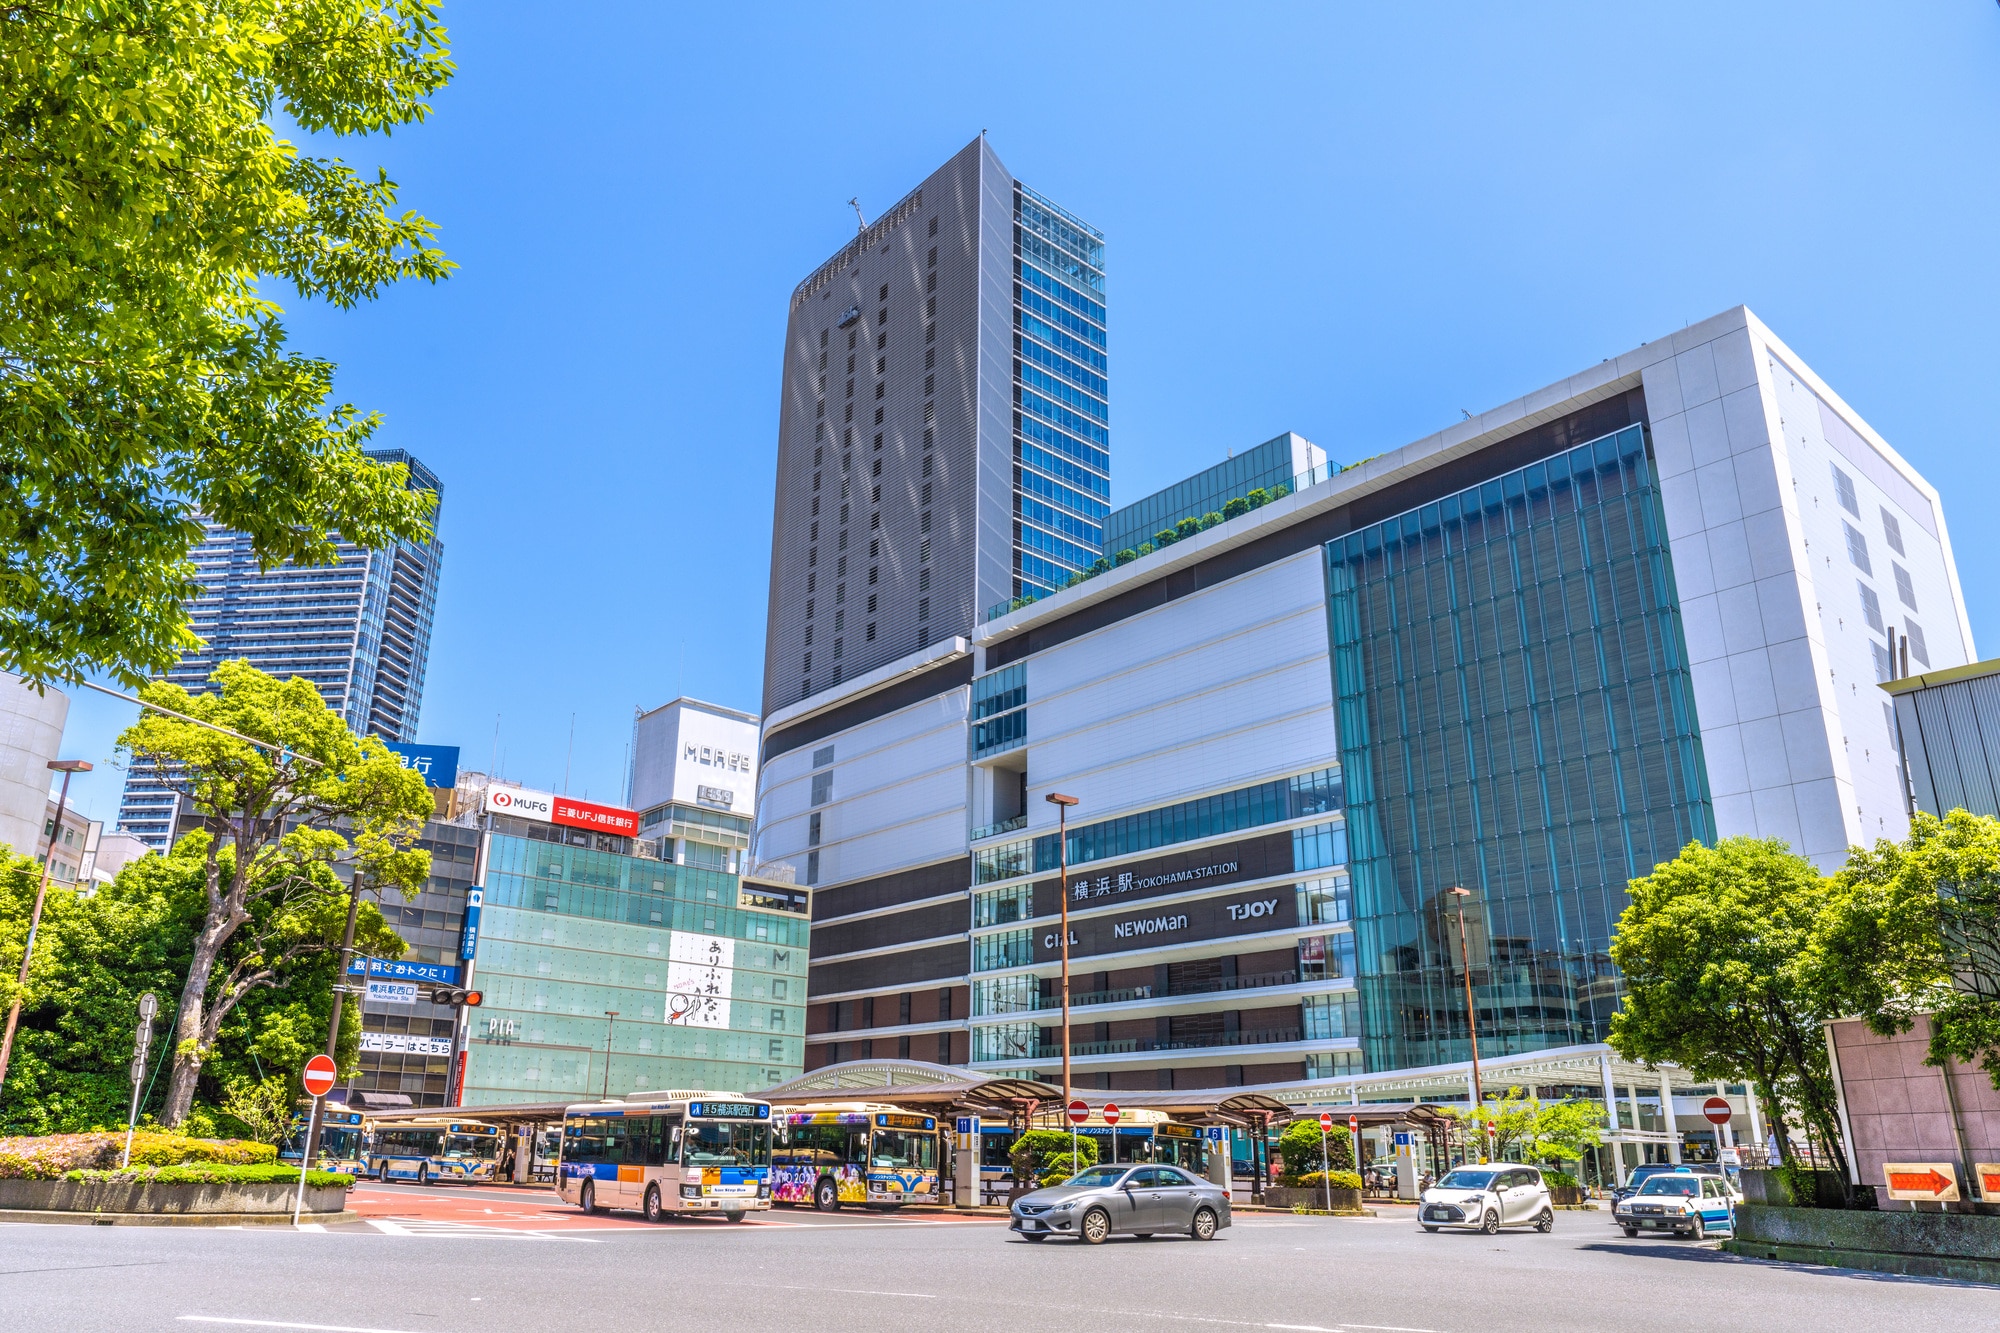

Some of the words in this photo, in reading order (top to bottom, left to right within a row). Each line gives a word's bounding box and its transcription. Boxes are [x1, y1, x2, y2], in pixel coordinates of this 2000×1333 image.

[513, 797, 547, 813] MUFG
[557, 806, 634, 829] 三菱UFJ信託銀行
[1074, 872, 1134, 901] 横浜駅
[1137, 871, 1193, 890] YOKOHAMA
[1195, 861, 1239, 880] STATION
[703, 940, 722, 1022] ありふれない
[370, 984, 415, 996] 横浜駅西口
[489, 1018, 514, 1036] PIA
[960, 1120, 968, 1132] 11
[1212, 1128, 1219, 1140] 6
